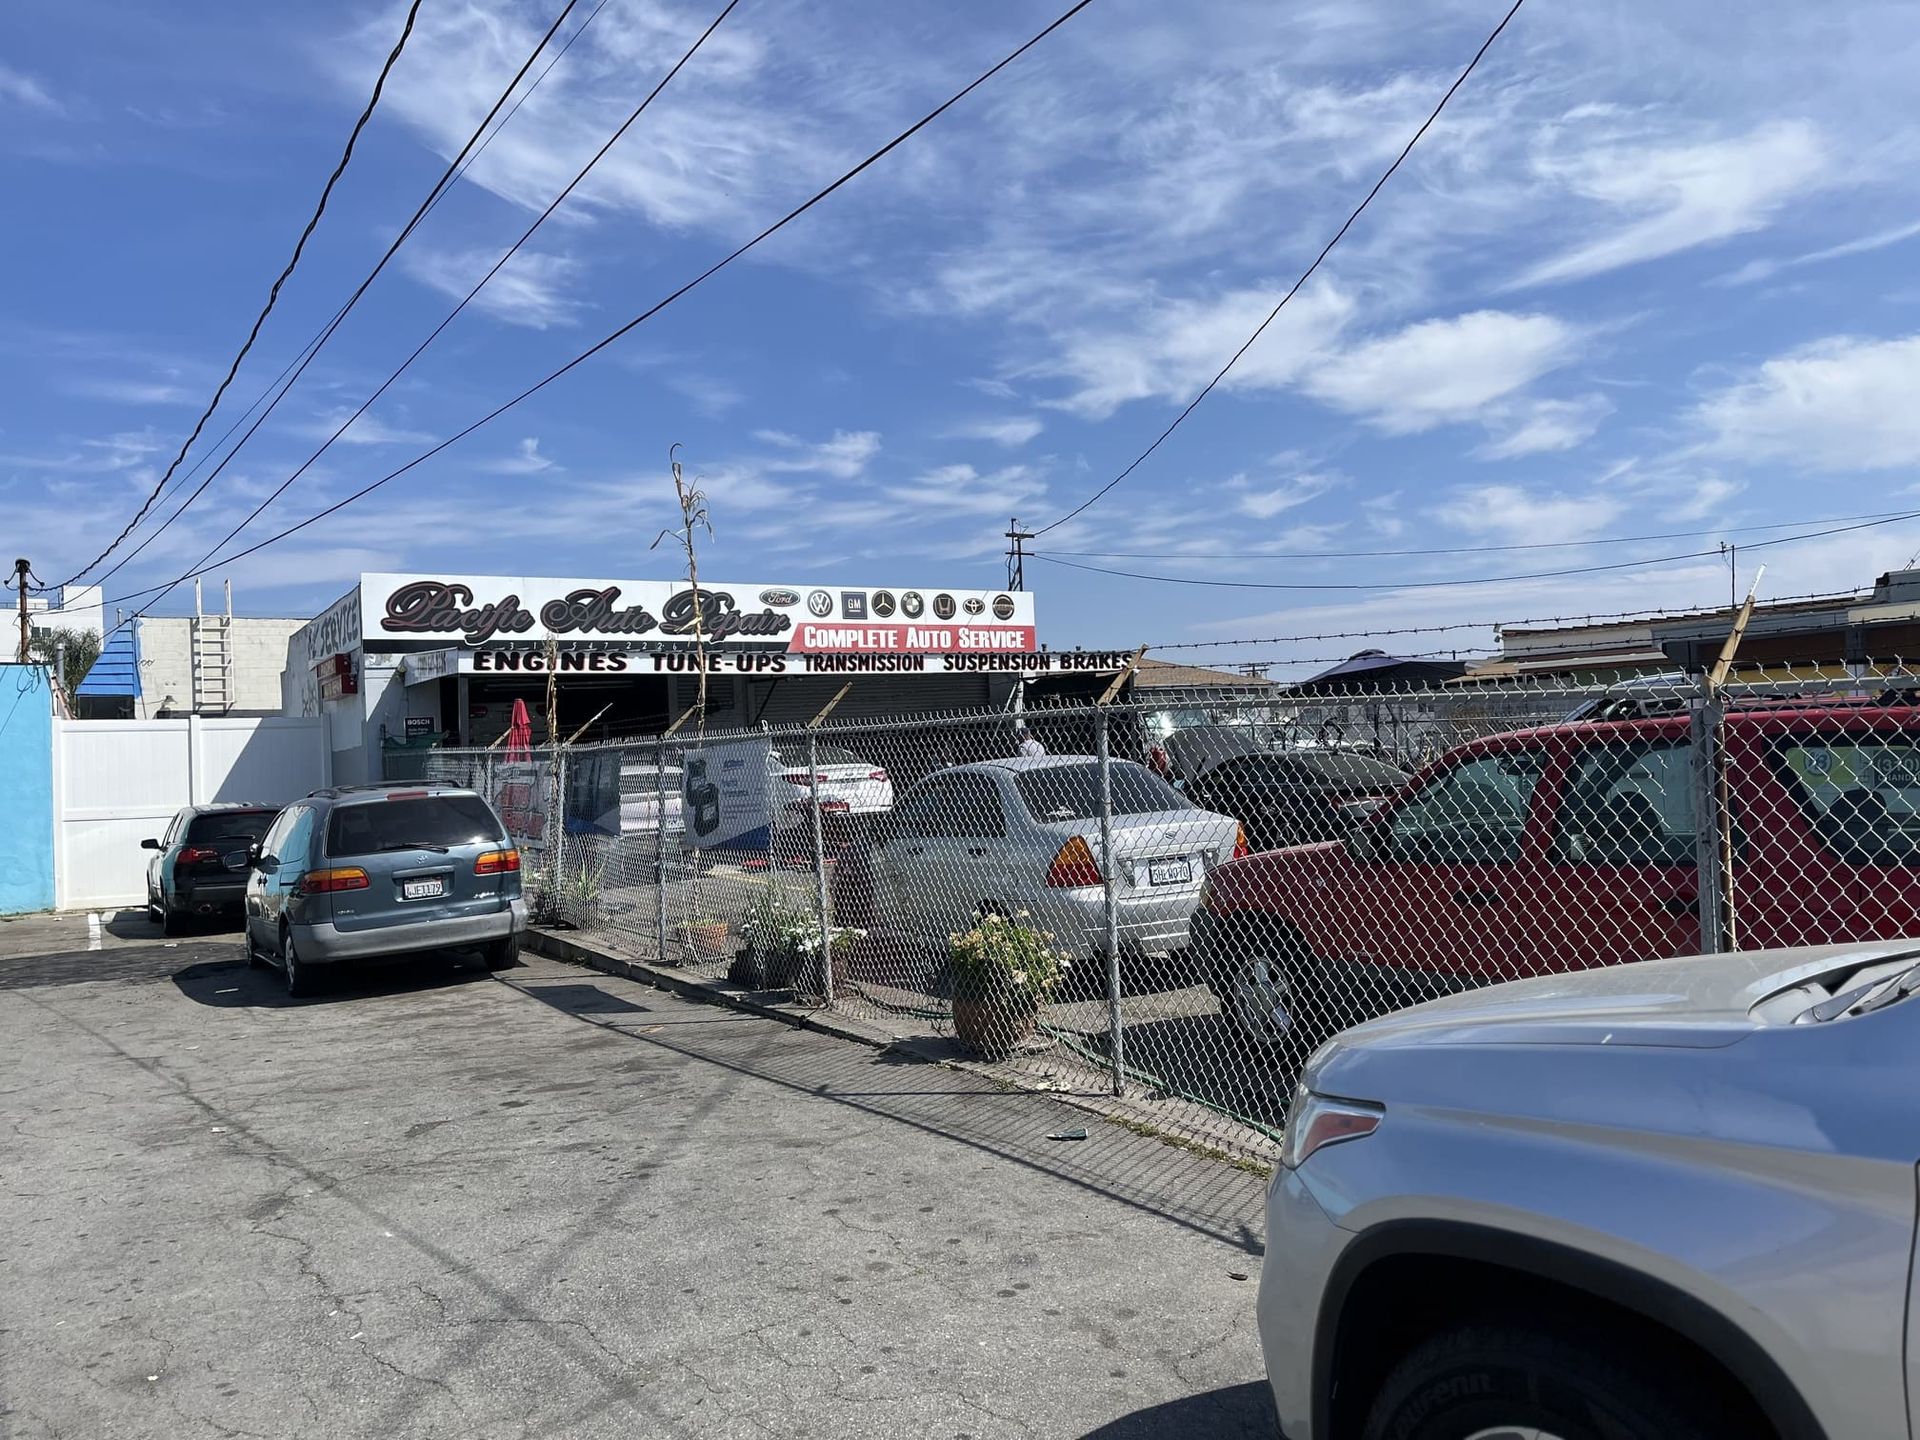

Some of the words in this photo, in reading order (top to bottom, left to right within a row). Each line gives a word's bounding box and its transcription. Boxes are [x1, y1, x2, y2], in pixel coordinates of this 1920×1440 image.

[381, 581, 535, 645] Pacific
[540, 586, 658, 634] Auto
[659, 588, 792, 642] Repair
[848, 599, 861, 609] GM
[804, 625, 898, 649] COMPLETE
[906, 626, 951, 648] AUTO
[958, 627, 1025, 648] SERVICE
[473, 651, 627, 671] ENGINES
[650, 653, 787, 672] TUNE-UPS
[803, 654, 925, 672] TRANSMISSION
[943, 653, 1050, 671] SUSPENSION
[1060, 653, 1133, 670] BRAKES
[407, 718, 430, 726] BOSCH
